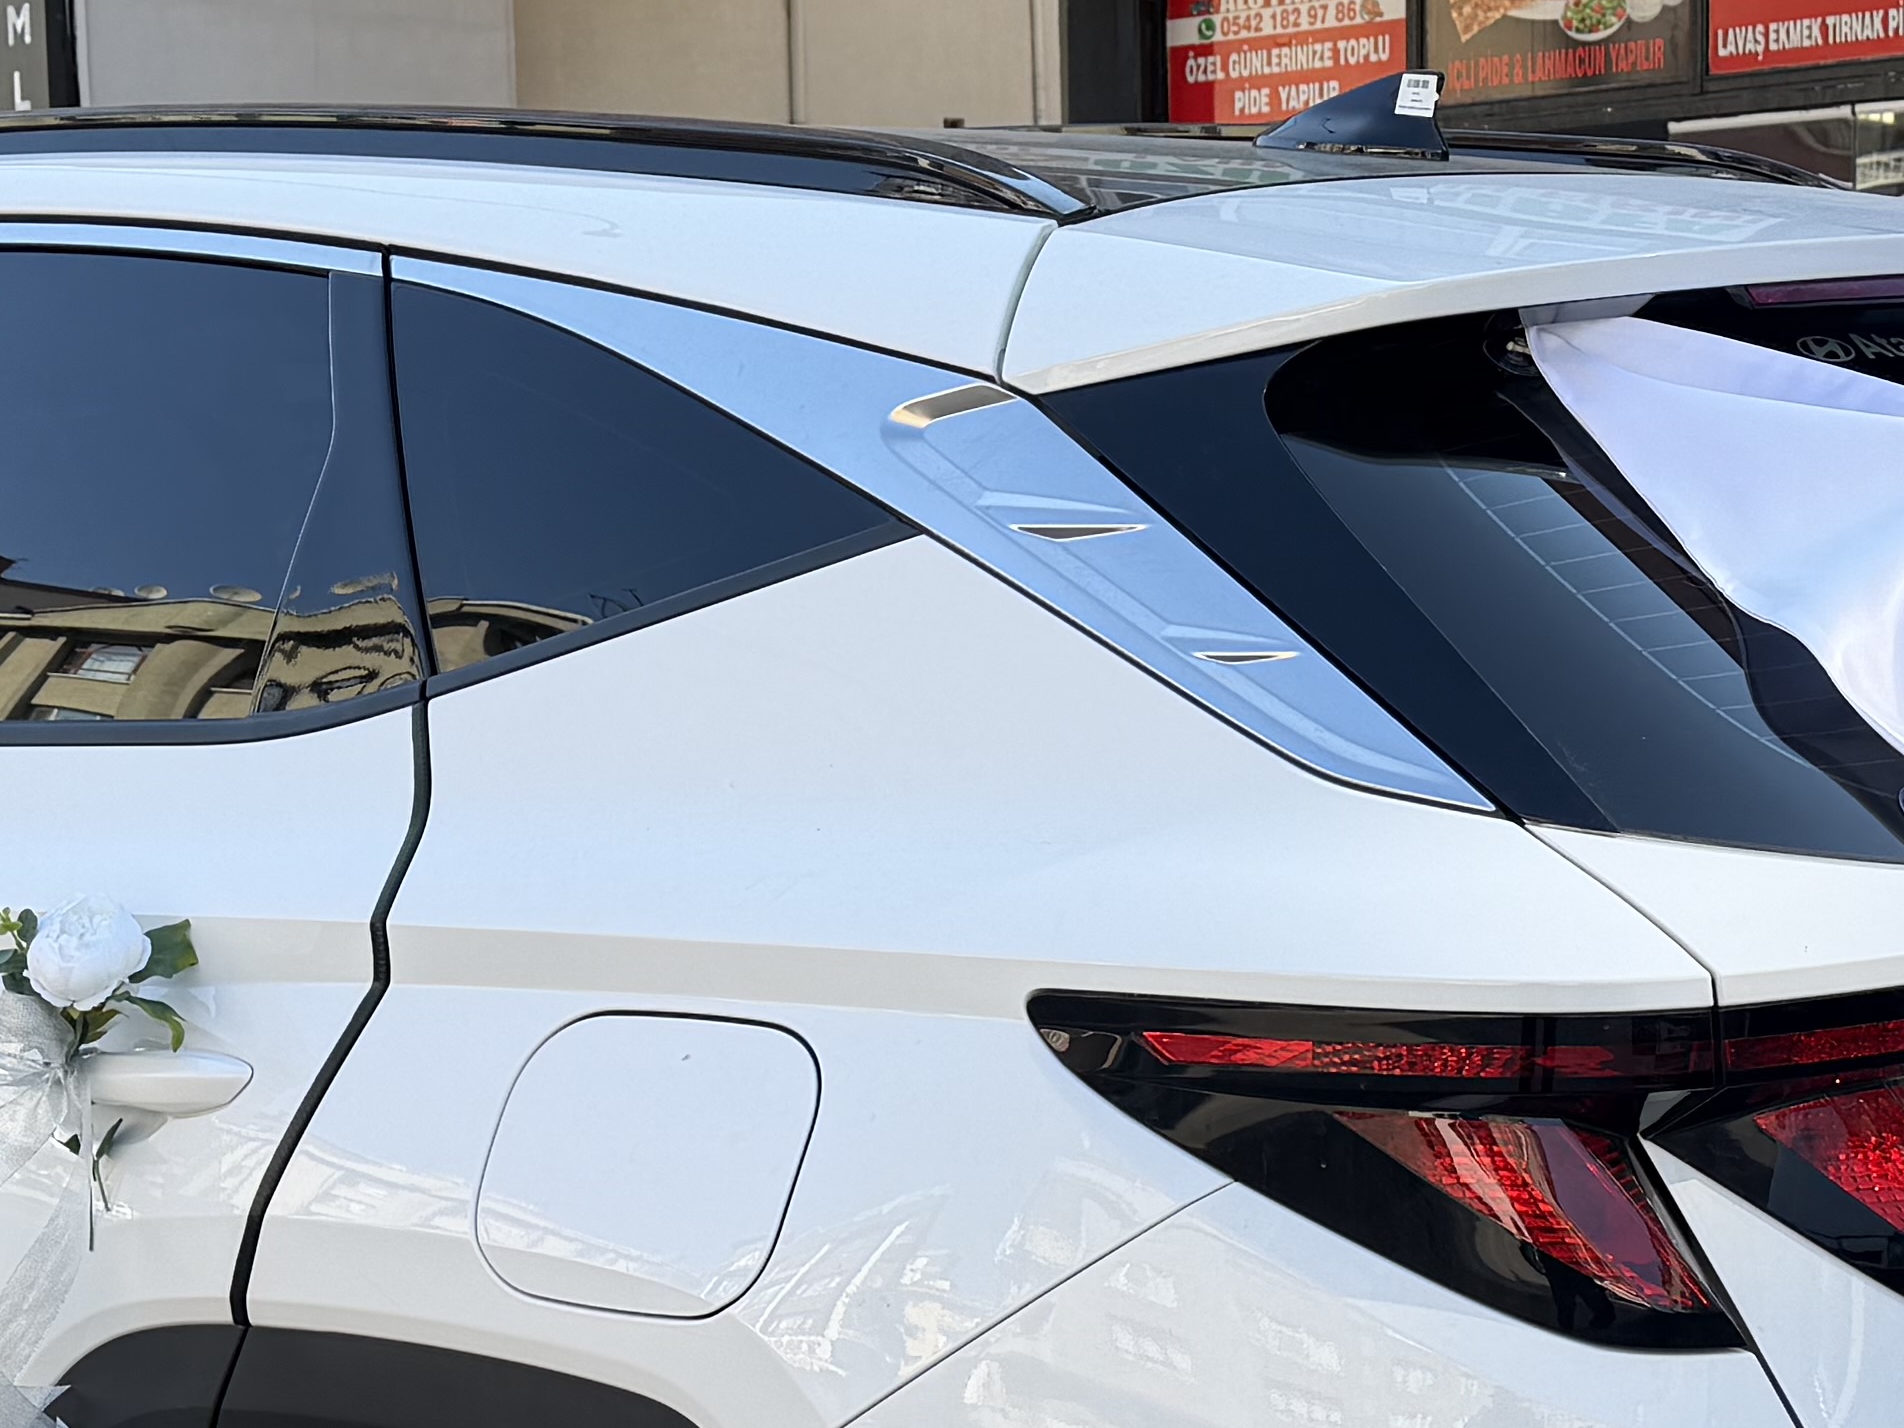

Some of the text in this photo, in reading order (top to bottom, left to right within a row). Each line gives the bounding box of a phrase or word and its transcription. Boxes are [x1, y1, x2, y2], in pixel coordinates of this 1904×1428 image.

[1220, 0, 1357, 37] 0542 182 97 86
[1717, 25, 1765, 60] LAVAŞ
[1769, 17, 1823, 51] EKMEK
[1826, 9, 1884, 45] TIRNAK
[1185, 34, 1390, 83] ÖZEL GÜNLERİNİZE TOPLU
[1514, 54, 1523, 84] &
[1528, 44, 1605, 82] LAHMACUN
[1610, 38, 1664, 72] YAPILIR
[1234, 84, 1270, 116] PİDE
